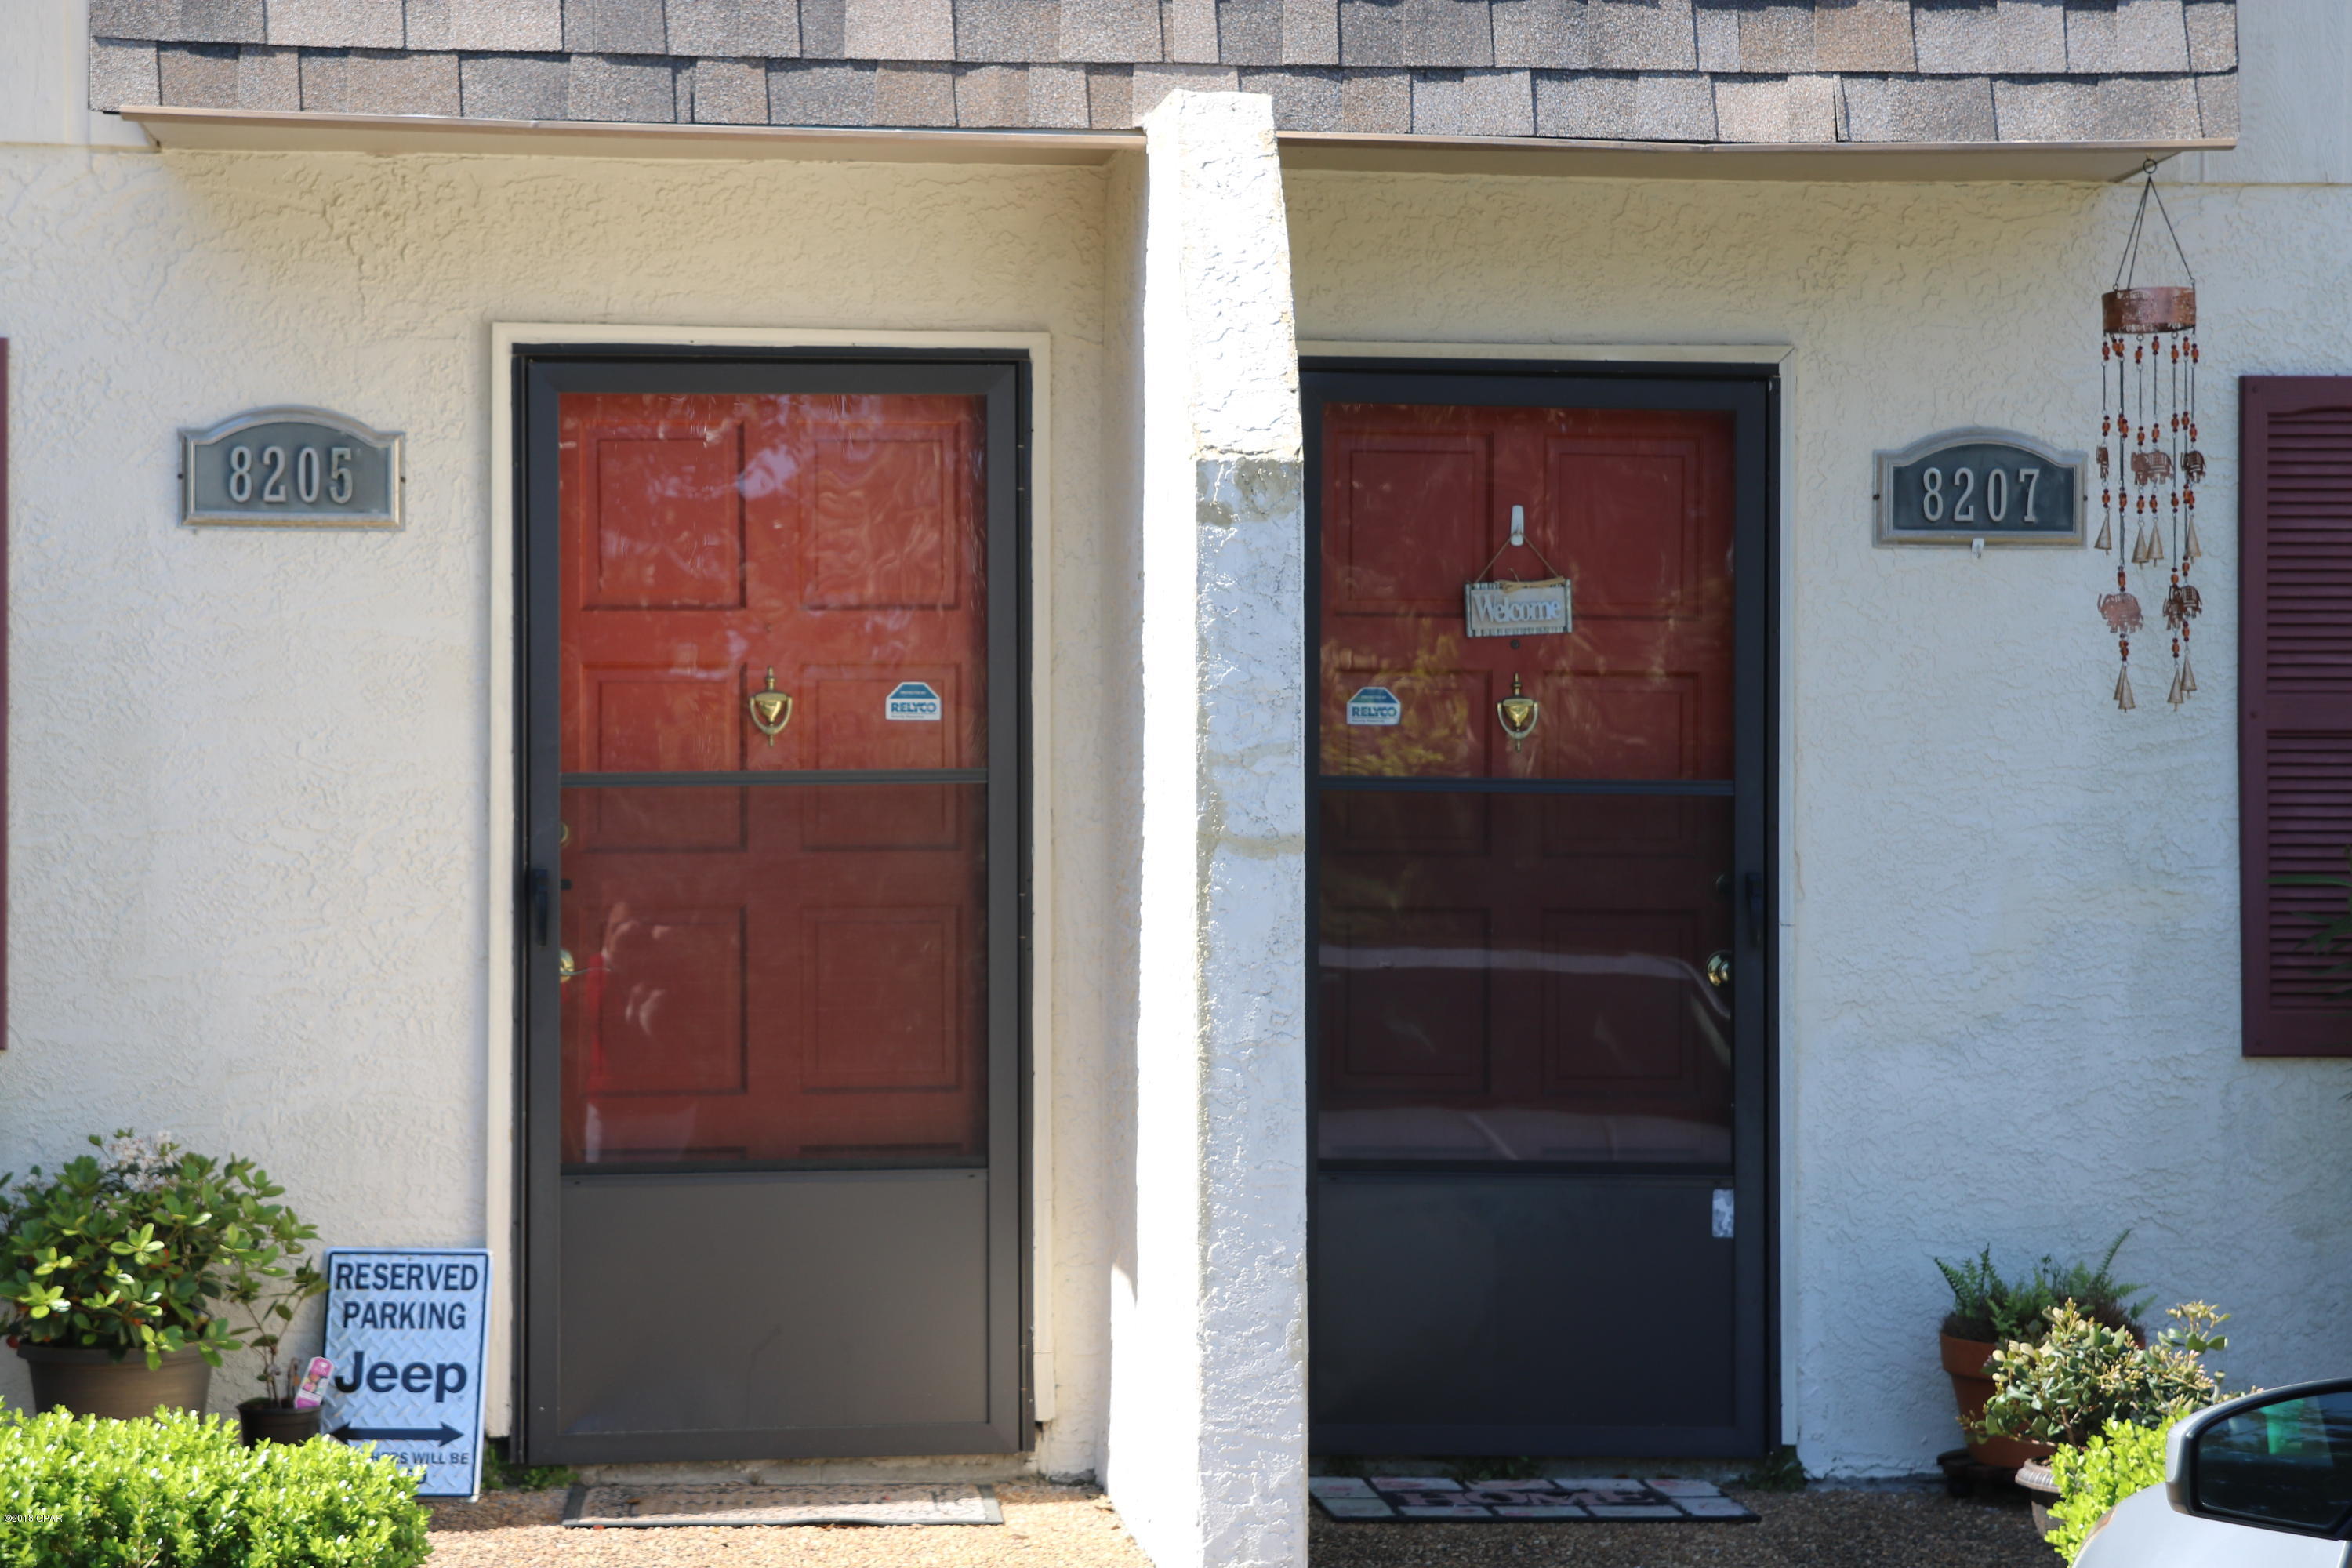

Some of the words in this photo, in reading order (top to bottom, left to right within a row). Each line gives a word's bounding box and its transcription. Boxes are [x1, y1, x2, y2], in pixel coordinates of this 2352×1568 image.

[229, 445, 354, 505] 8205
[1922, 466, 2041, 523] 8207
[1472, 593, 1562, 623] Welcome
[890, 702, 937, 713] RELYCO
[1351, 706, 1398, 717] RELYCO
[335, 1262, 478, 1291] RESERVED
[342, 1301, 466, 1330] PARKING
[334, 1350, 468, 1403] Jeep
[412, 1452, 445, 1465] WILL
[450, 1452, 470, 1465] BE
[1393, 1489, 1657, 1506] HOME
